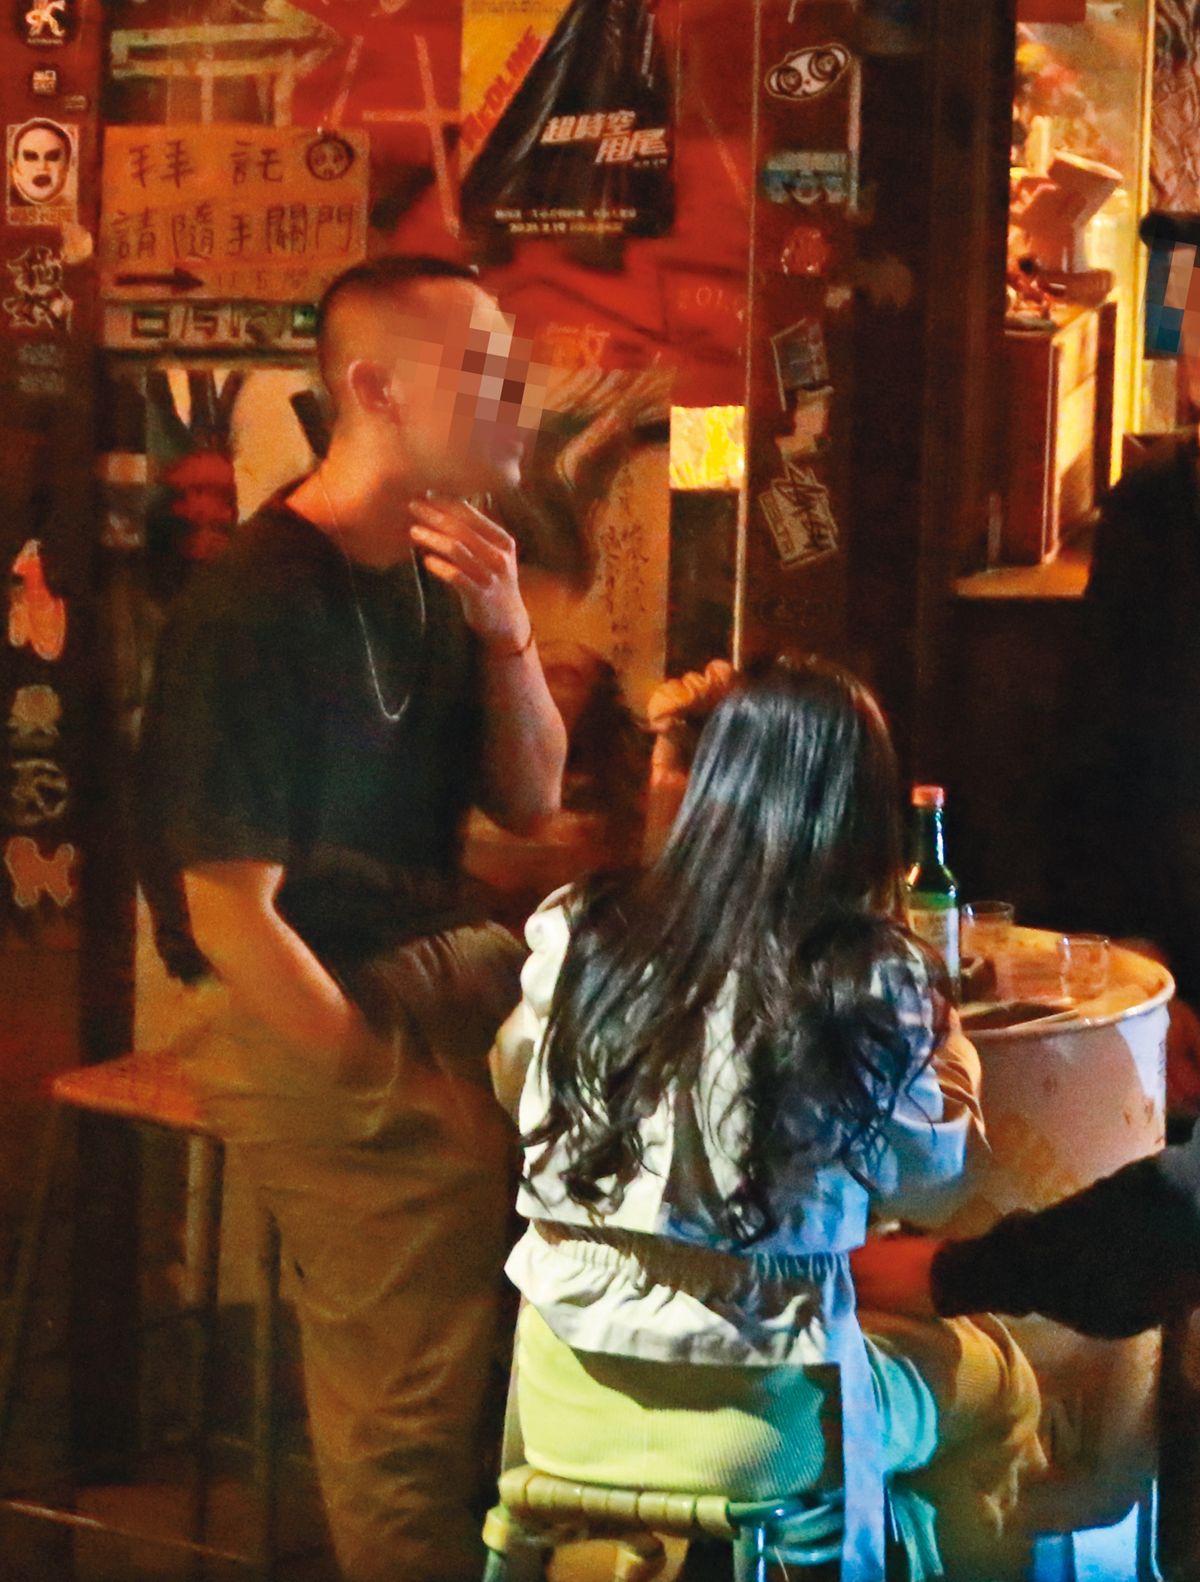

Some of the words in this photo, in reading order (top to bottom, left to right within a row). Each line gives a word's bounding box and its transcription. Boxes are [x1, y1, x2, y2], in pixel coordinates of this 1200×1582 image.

[540, 110, 637, 144] 超時空
[111, 203, 354, 260] 請隨手關門
